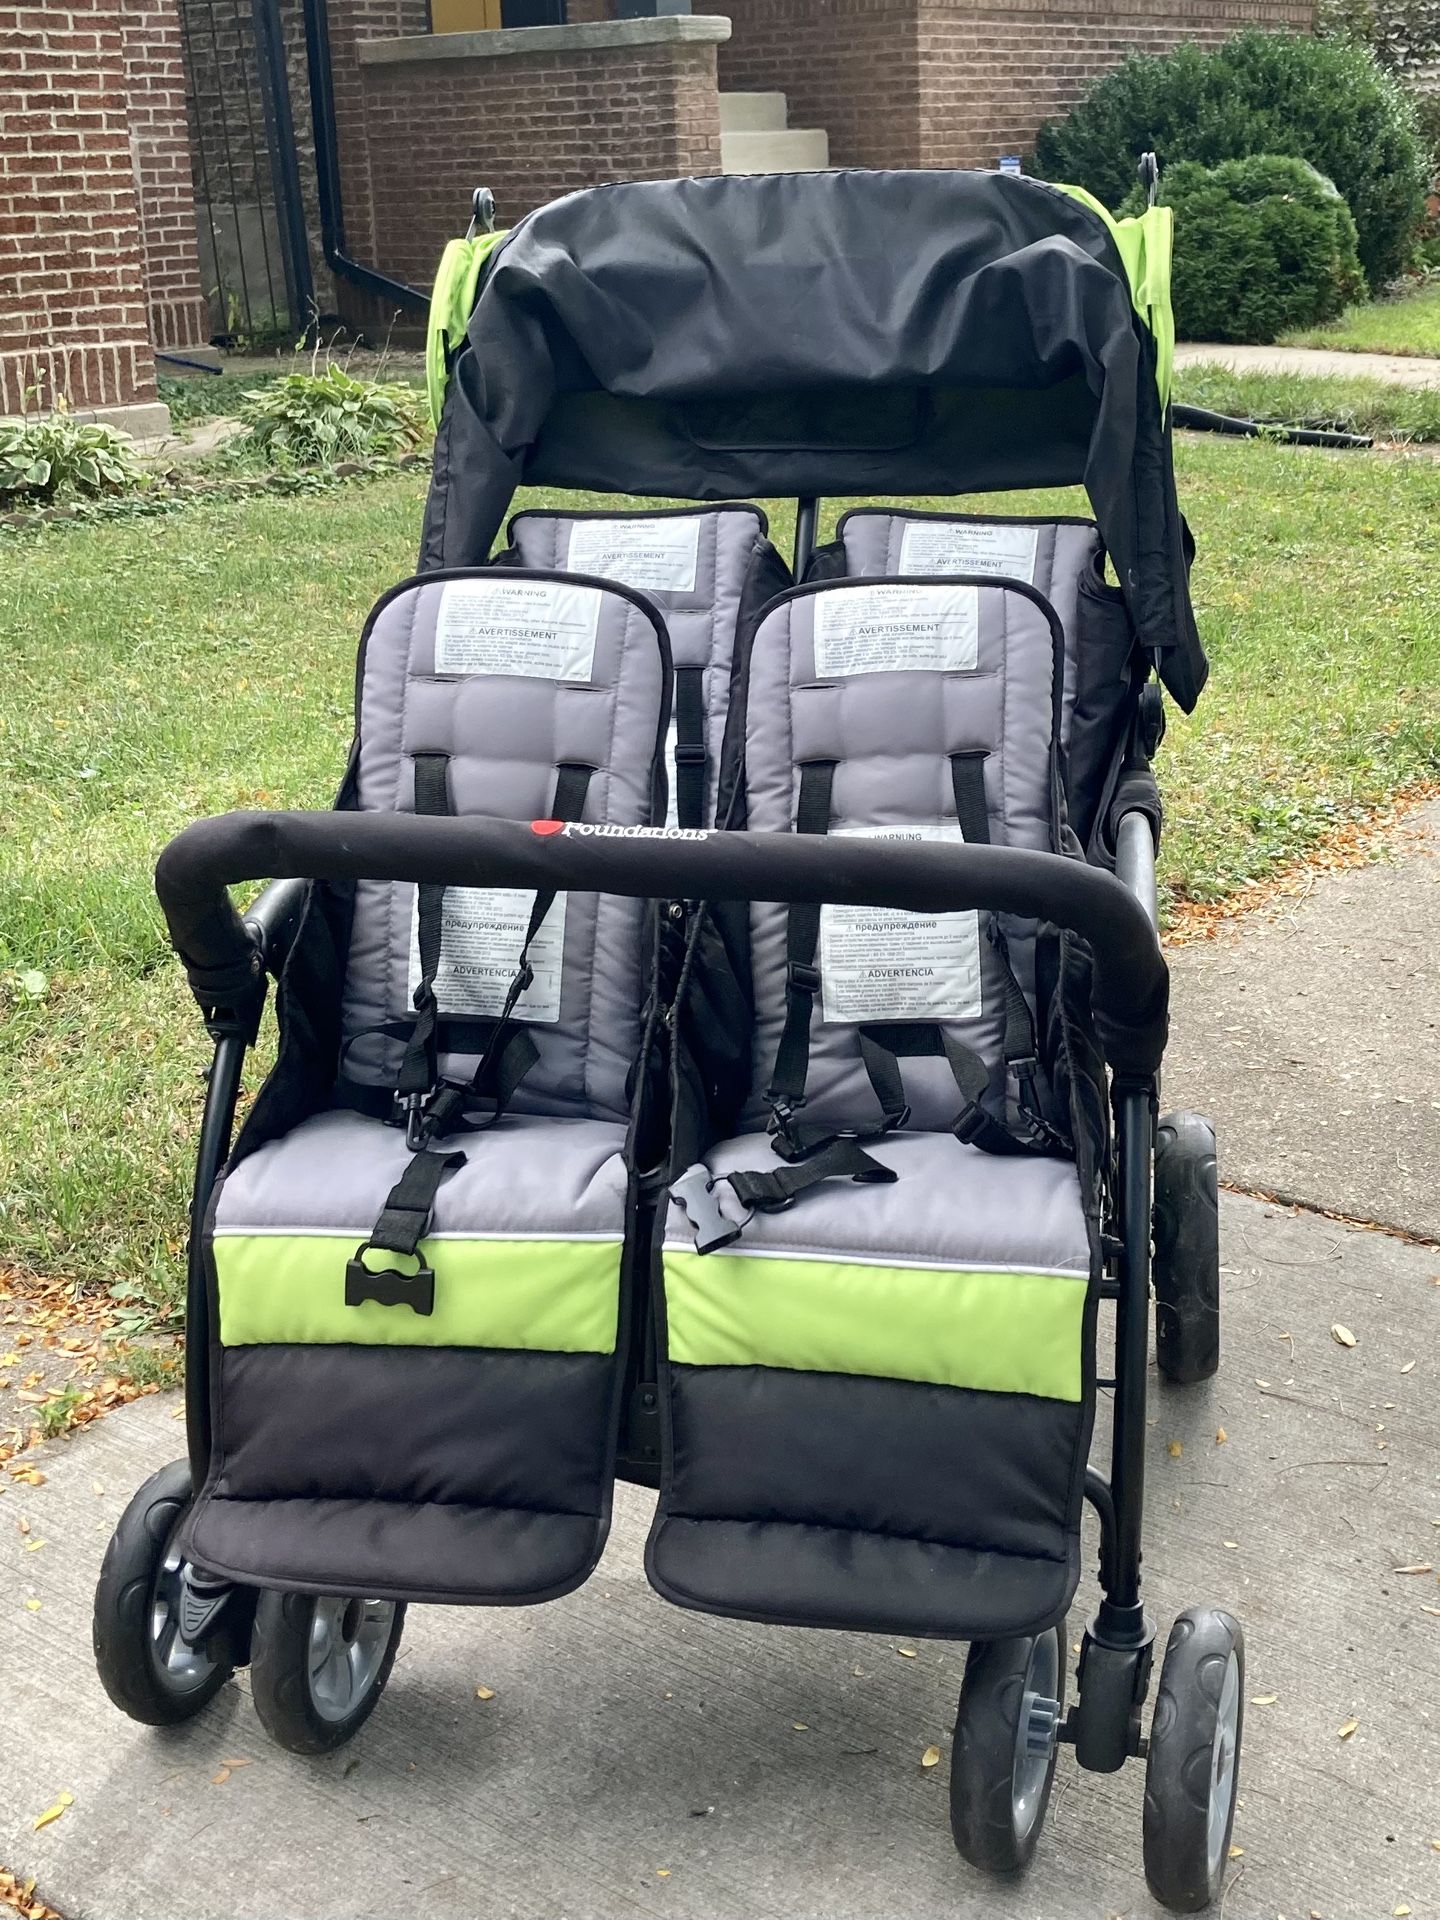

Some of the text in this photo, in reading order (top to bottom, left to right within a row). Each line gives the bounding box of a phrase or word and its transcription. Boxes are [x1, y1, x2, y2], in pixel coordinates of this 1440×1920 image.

[602, 552, 665, 560] AVERTISSEMENT
[936, 558, 1003, 568] AVERTISSEMENT
[502, 588, 547, 597] WARNING
[478, 627, 558, 640] AVERTISSEMENT
[858, 623, 940, 635] AVERTISSEMENT
[561, 821, 708, 841] Foundations
[874, 832, 922, 841] WARNUNG
[445, 920, 525, 932] предупреждение
[855, 921, 938, 931] предупреждение
[453, 965, 517, 977] ADVERTENCIA
[868, 968, 934, 978] ADVERTENCIA
